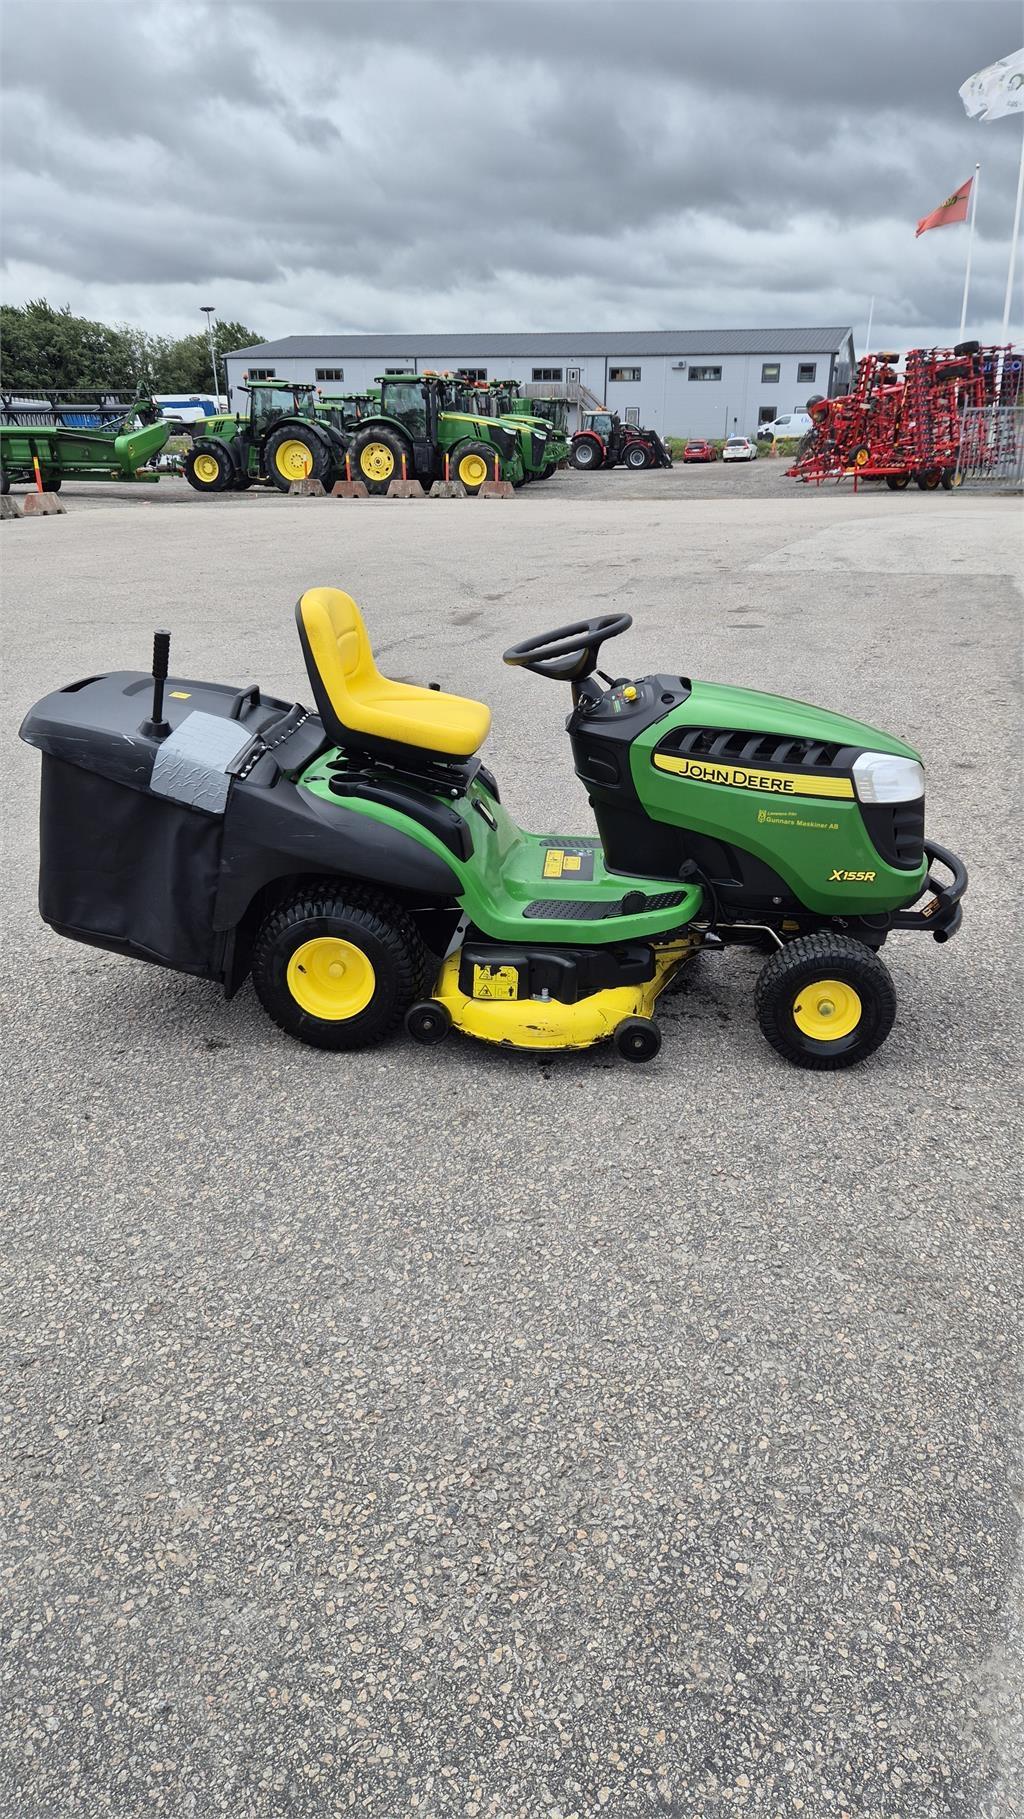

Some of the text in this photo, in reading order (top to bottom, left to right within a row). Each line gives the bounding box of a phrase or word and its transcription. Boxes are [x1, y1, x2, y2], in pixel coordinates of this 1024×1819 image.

[679, 761, 794, 791] JOHN DEERE
[766, 816, 795, 825] Gunnars
[796, 819, 828, 828] Maskiner
[828, 869, 876, 881] X155R
